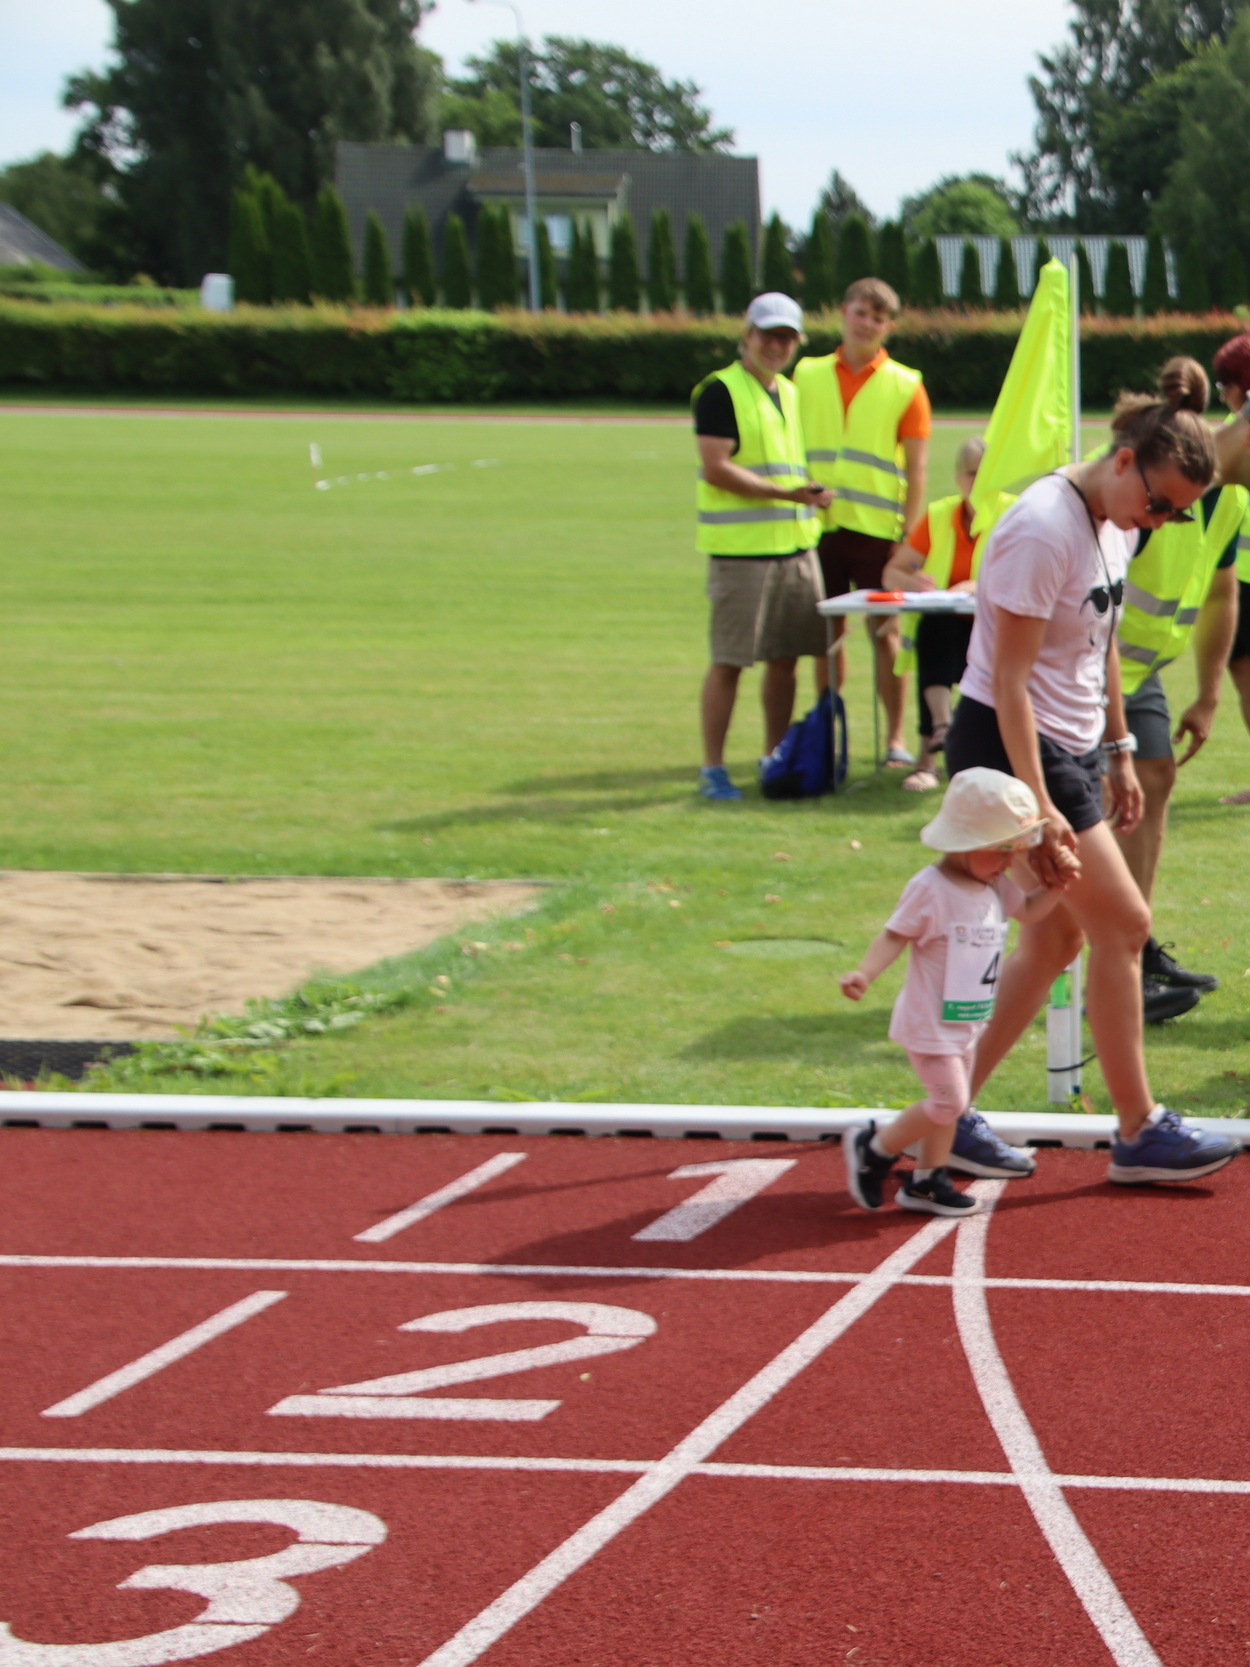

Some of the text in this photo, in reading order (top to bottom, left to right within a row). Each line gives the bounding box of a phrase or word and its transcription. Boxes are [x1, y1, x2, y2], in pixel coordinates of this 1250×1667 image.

[980, 951, 1000, 993] 4
[630, 1158, 798, 1241] 1
[265, 1301, 658, 1420] 2
[0, 1499, 388, 1667] 3
